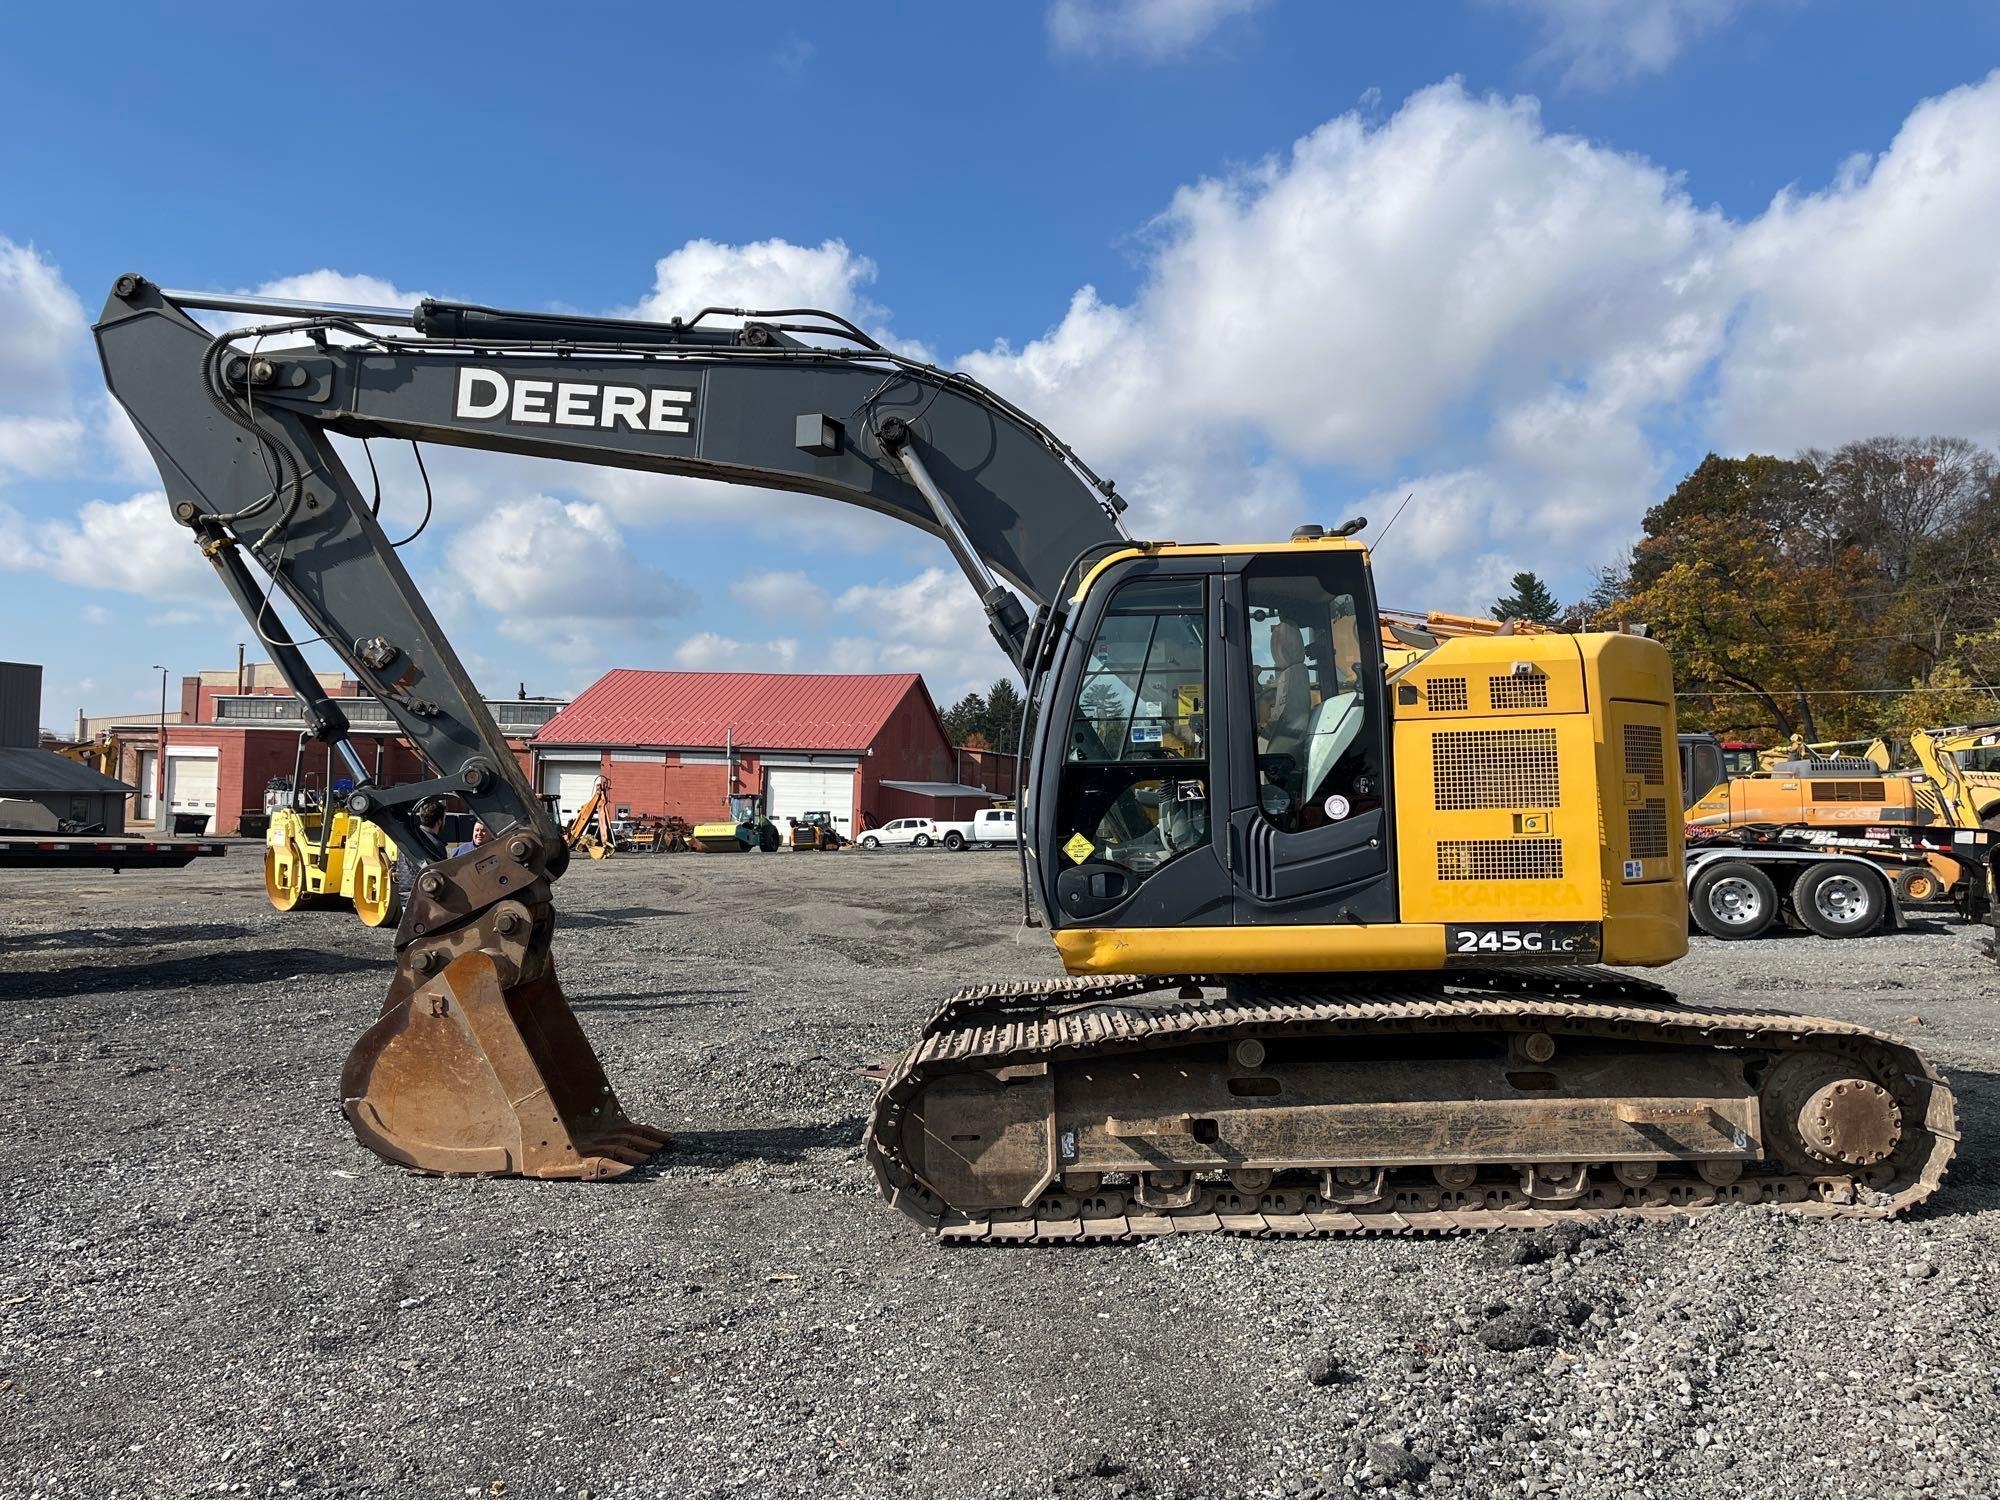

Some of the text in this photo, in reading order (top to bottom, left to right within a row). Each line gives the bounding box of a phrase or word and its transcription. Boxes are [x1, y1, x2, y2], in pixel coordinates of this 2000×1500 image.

[456, 367, 692, 433] DEERE
[1981, 735, 1996, 746] CAT
[1835, 808, 1879, 819] CASE
[1780, 829, 1838, 840] Eager
[1809, 836, 1880, 848] Beaver
[1431, 883, 1584, 908] SKANSKA
[1457, 930, 1574, 952] 245G LC
